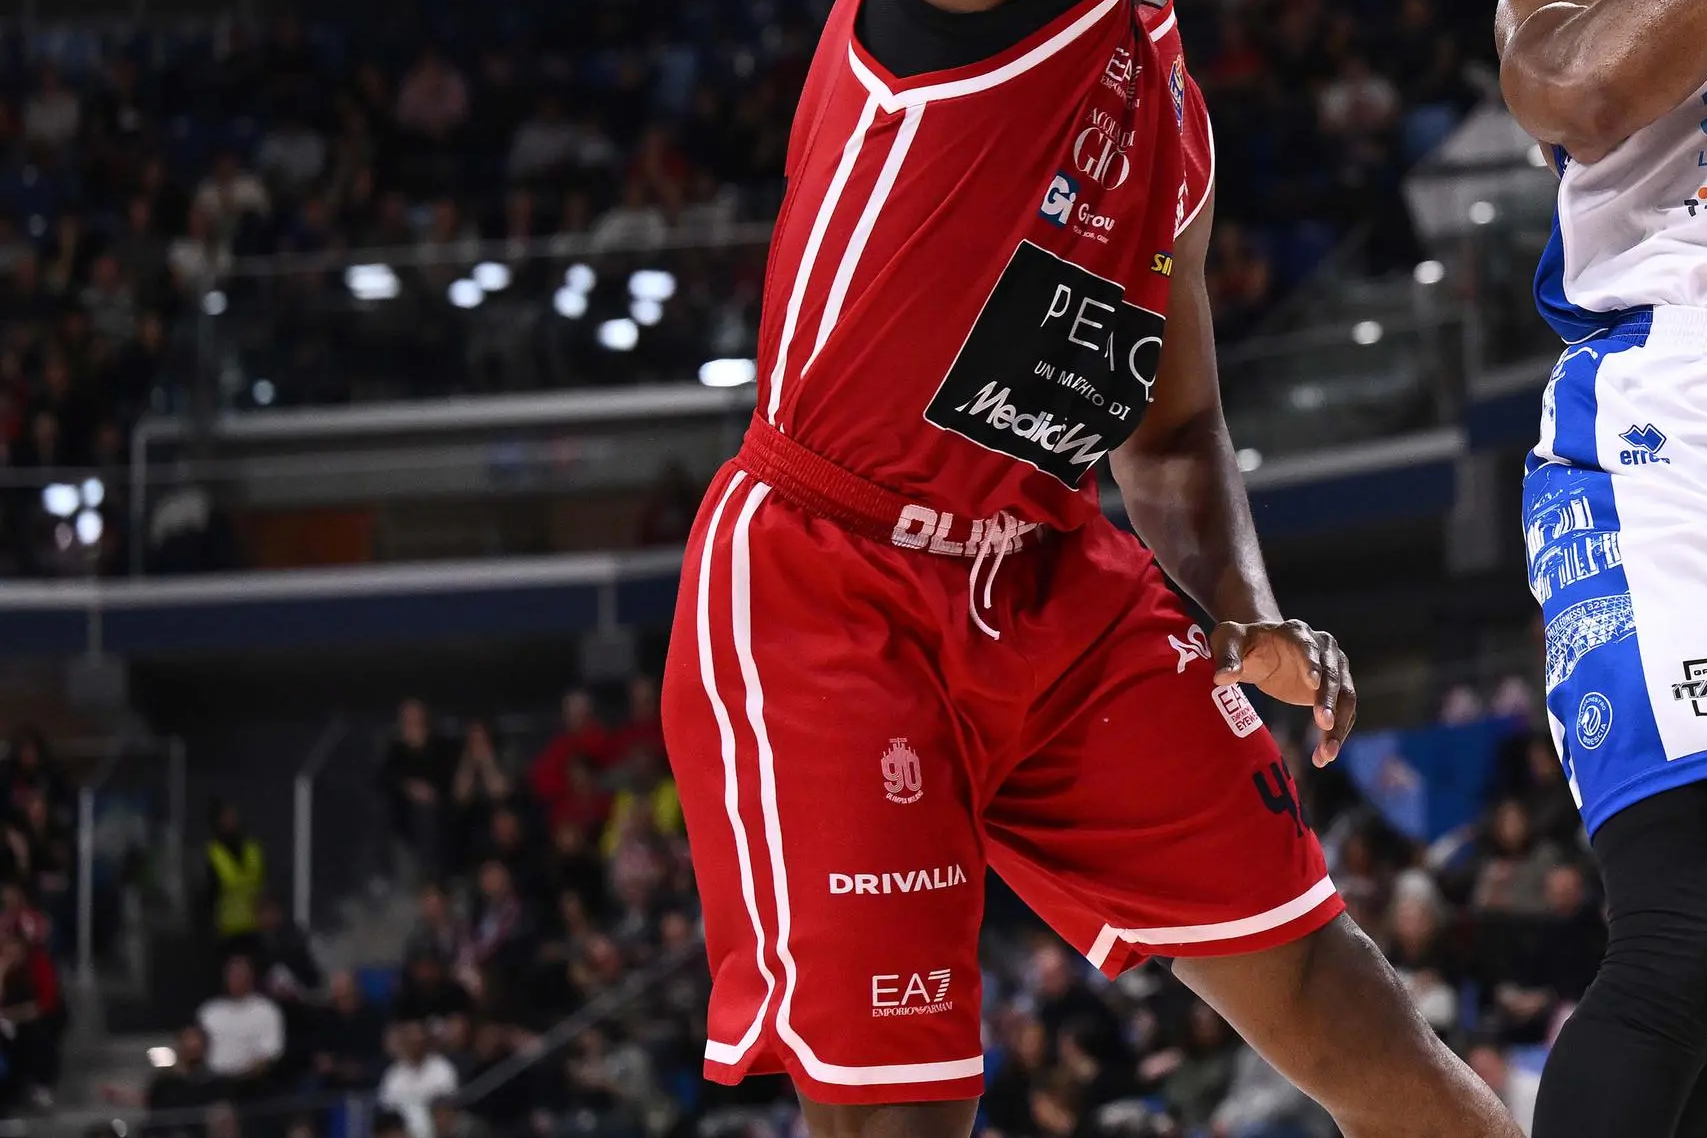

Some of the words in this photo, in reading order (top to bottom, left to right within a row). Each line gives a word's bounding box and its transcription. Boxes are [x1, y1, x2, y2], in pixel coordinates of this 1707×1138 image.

[1078, 203, 1116, 231] Grou
[1034, 360, 1056, 380] UN
[1109, 402, 1131, 420] DI
[1620, 448, 1671, 466] erre
[1582, 722, 1607, 746] BRESCIA
[829, 864, 967, 895] DRIVALIA
[872, 968, 951, 1007] EA7
[872, 1006, 915, 1018] EMPORIO
